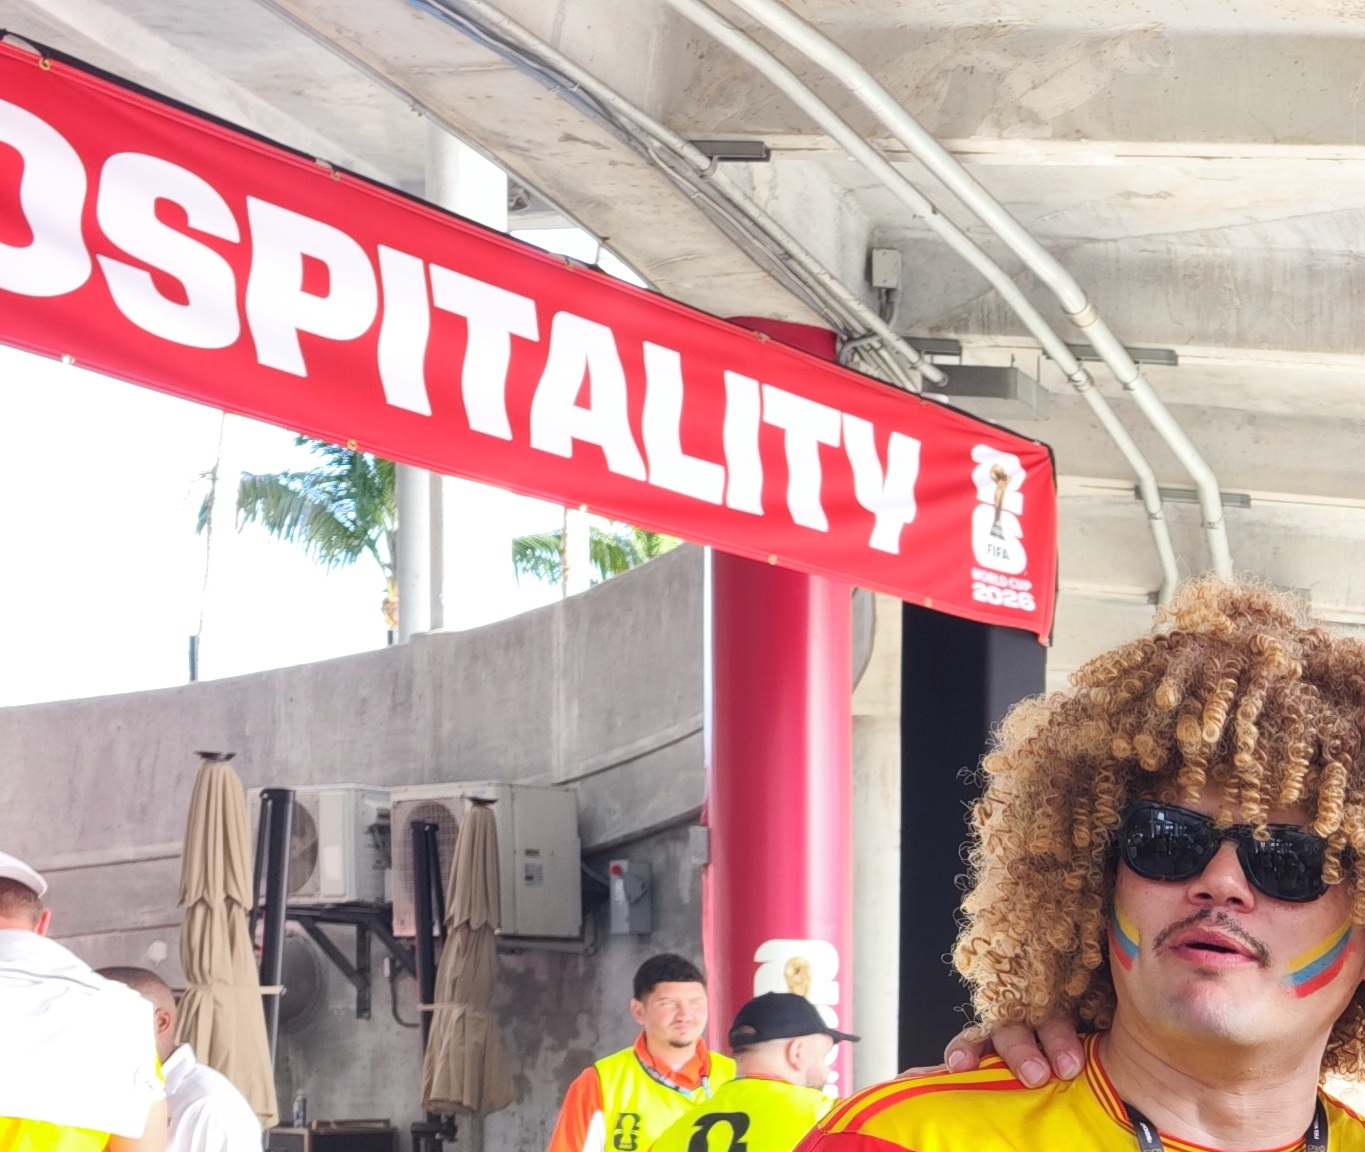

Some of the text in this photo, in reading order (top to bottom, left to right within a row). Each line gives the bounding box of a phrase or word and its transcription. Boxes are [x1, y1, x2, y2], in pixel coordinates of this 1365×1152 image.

[987, 544, 1010, 560] FIFA
[971, 567, 1032, 592] WORLD CUP
[972, 582, 1036, 612] 2026
